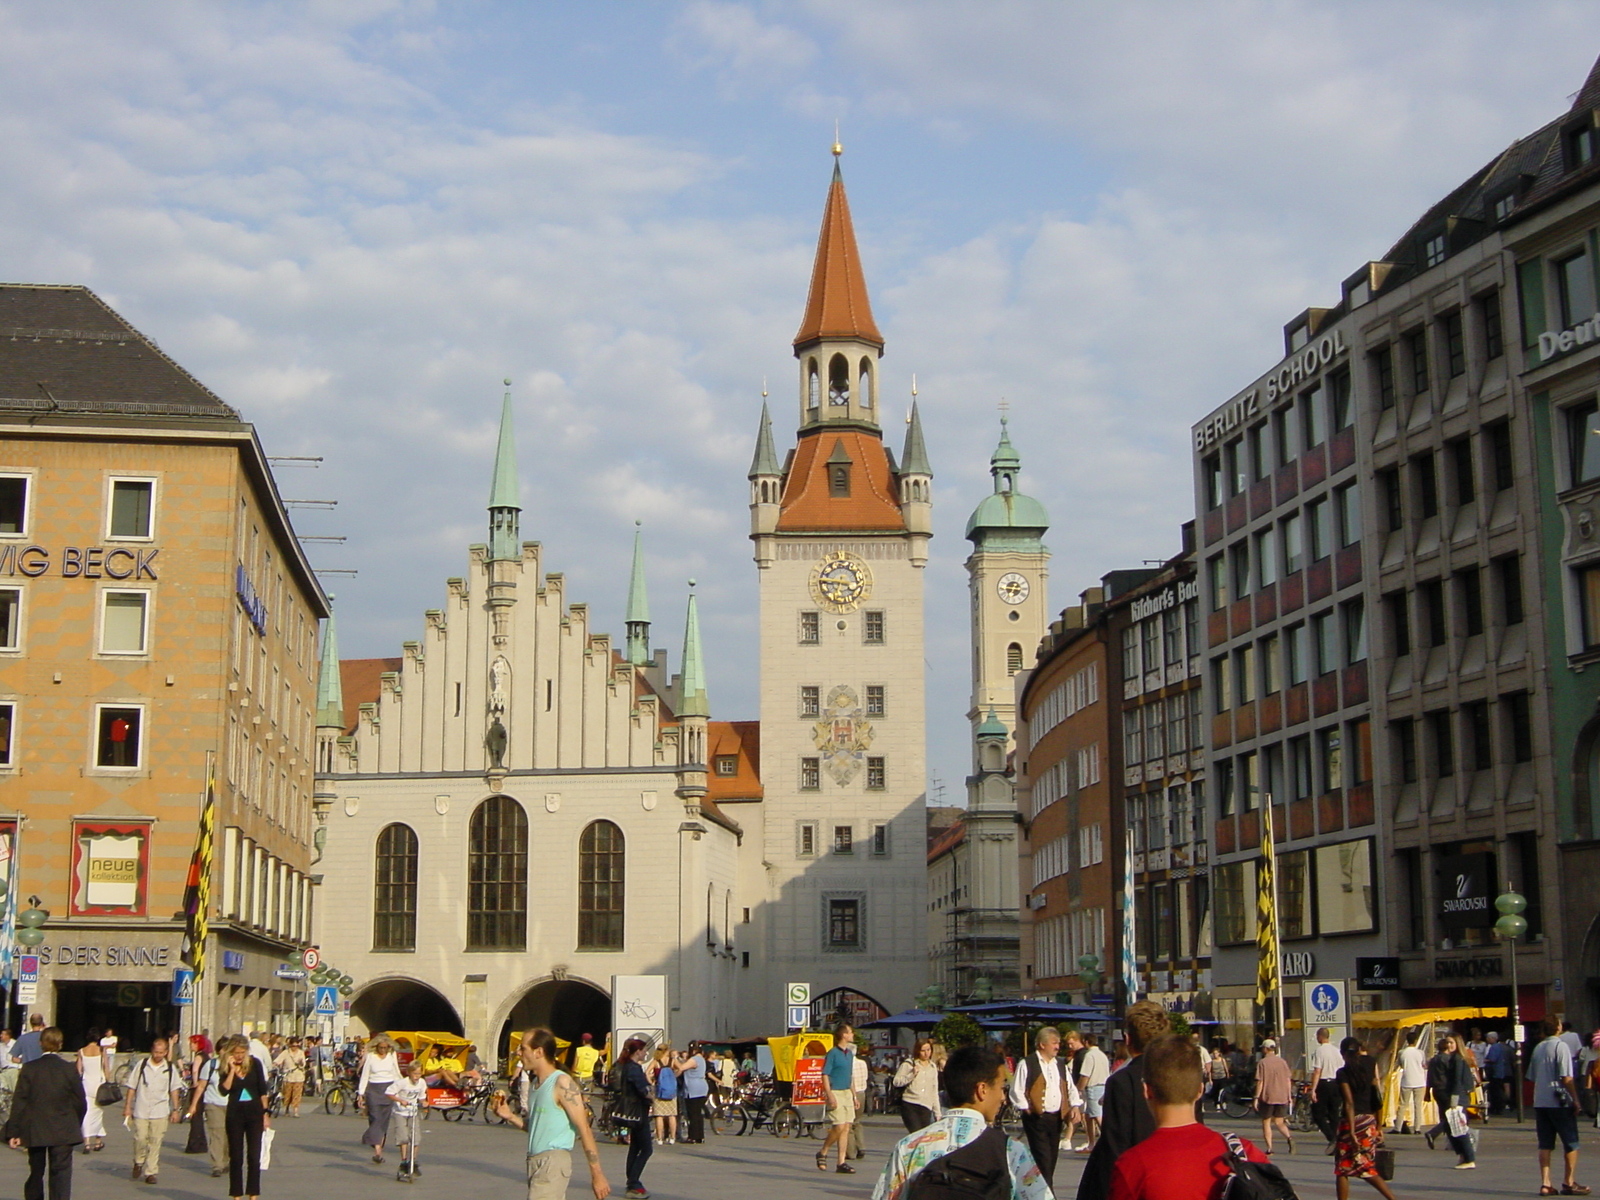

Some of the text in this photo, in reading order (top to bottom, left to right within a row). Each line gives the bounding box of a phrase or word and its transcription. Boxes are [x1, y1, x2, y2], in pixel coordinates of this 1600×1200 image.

[1195, 329, 1346, 452] BERLITZ SCHOOL
[62, 546, 160, 580] BECK
[91, 859, 135, 872] neue
[91, 872, 134, 882] kollektion
[1443, 896, 1488, 913] SWAROVSKI
[58, 945, 102, 966] DER
[106, 945, 169, 967] SINNE
[308, 954, 315, 964] 5
[1434, 957, 1504, 980] SWAROVSKI
[21, 973, 38, 982] TAXI
[1363, 977, 1398, 986] SWAROVSKI
[791, 985, 808, 1003] S
[792, 1008, 807, 1026] U
[1315, 1014, 1337, 1023] ZONE
